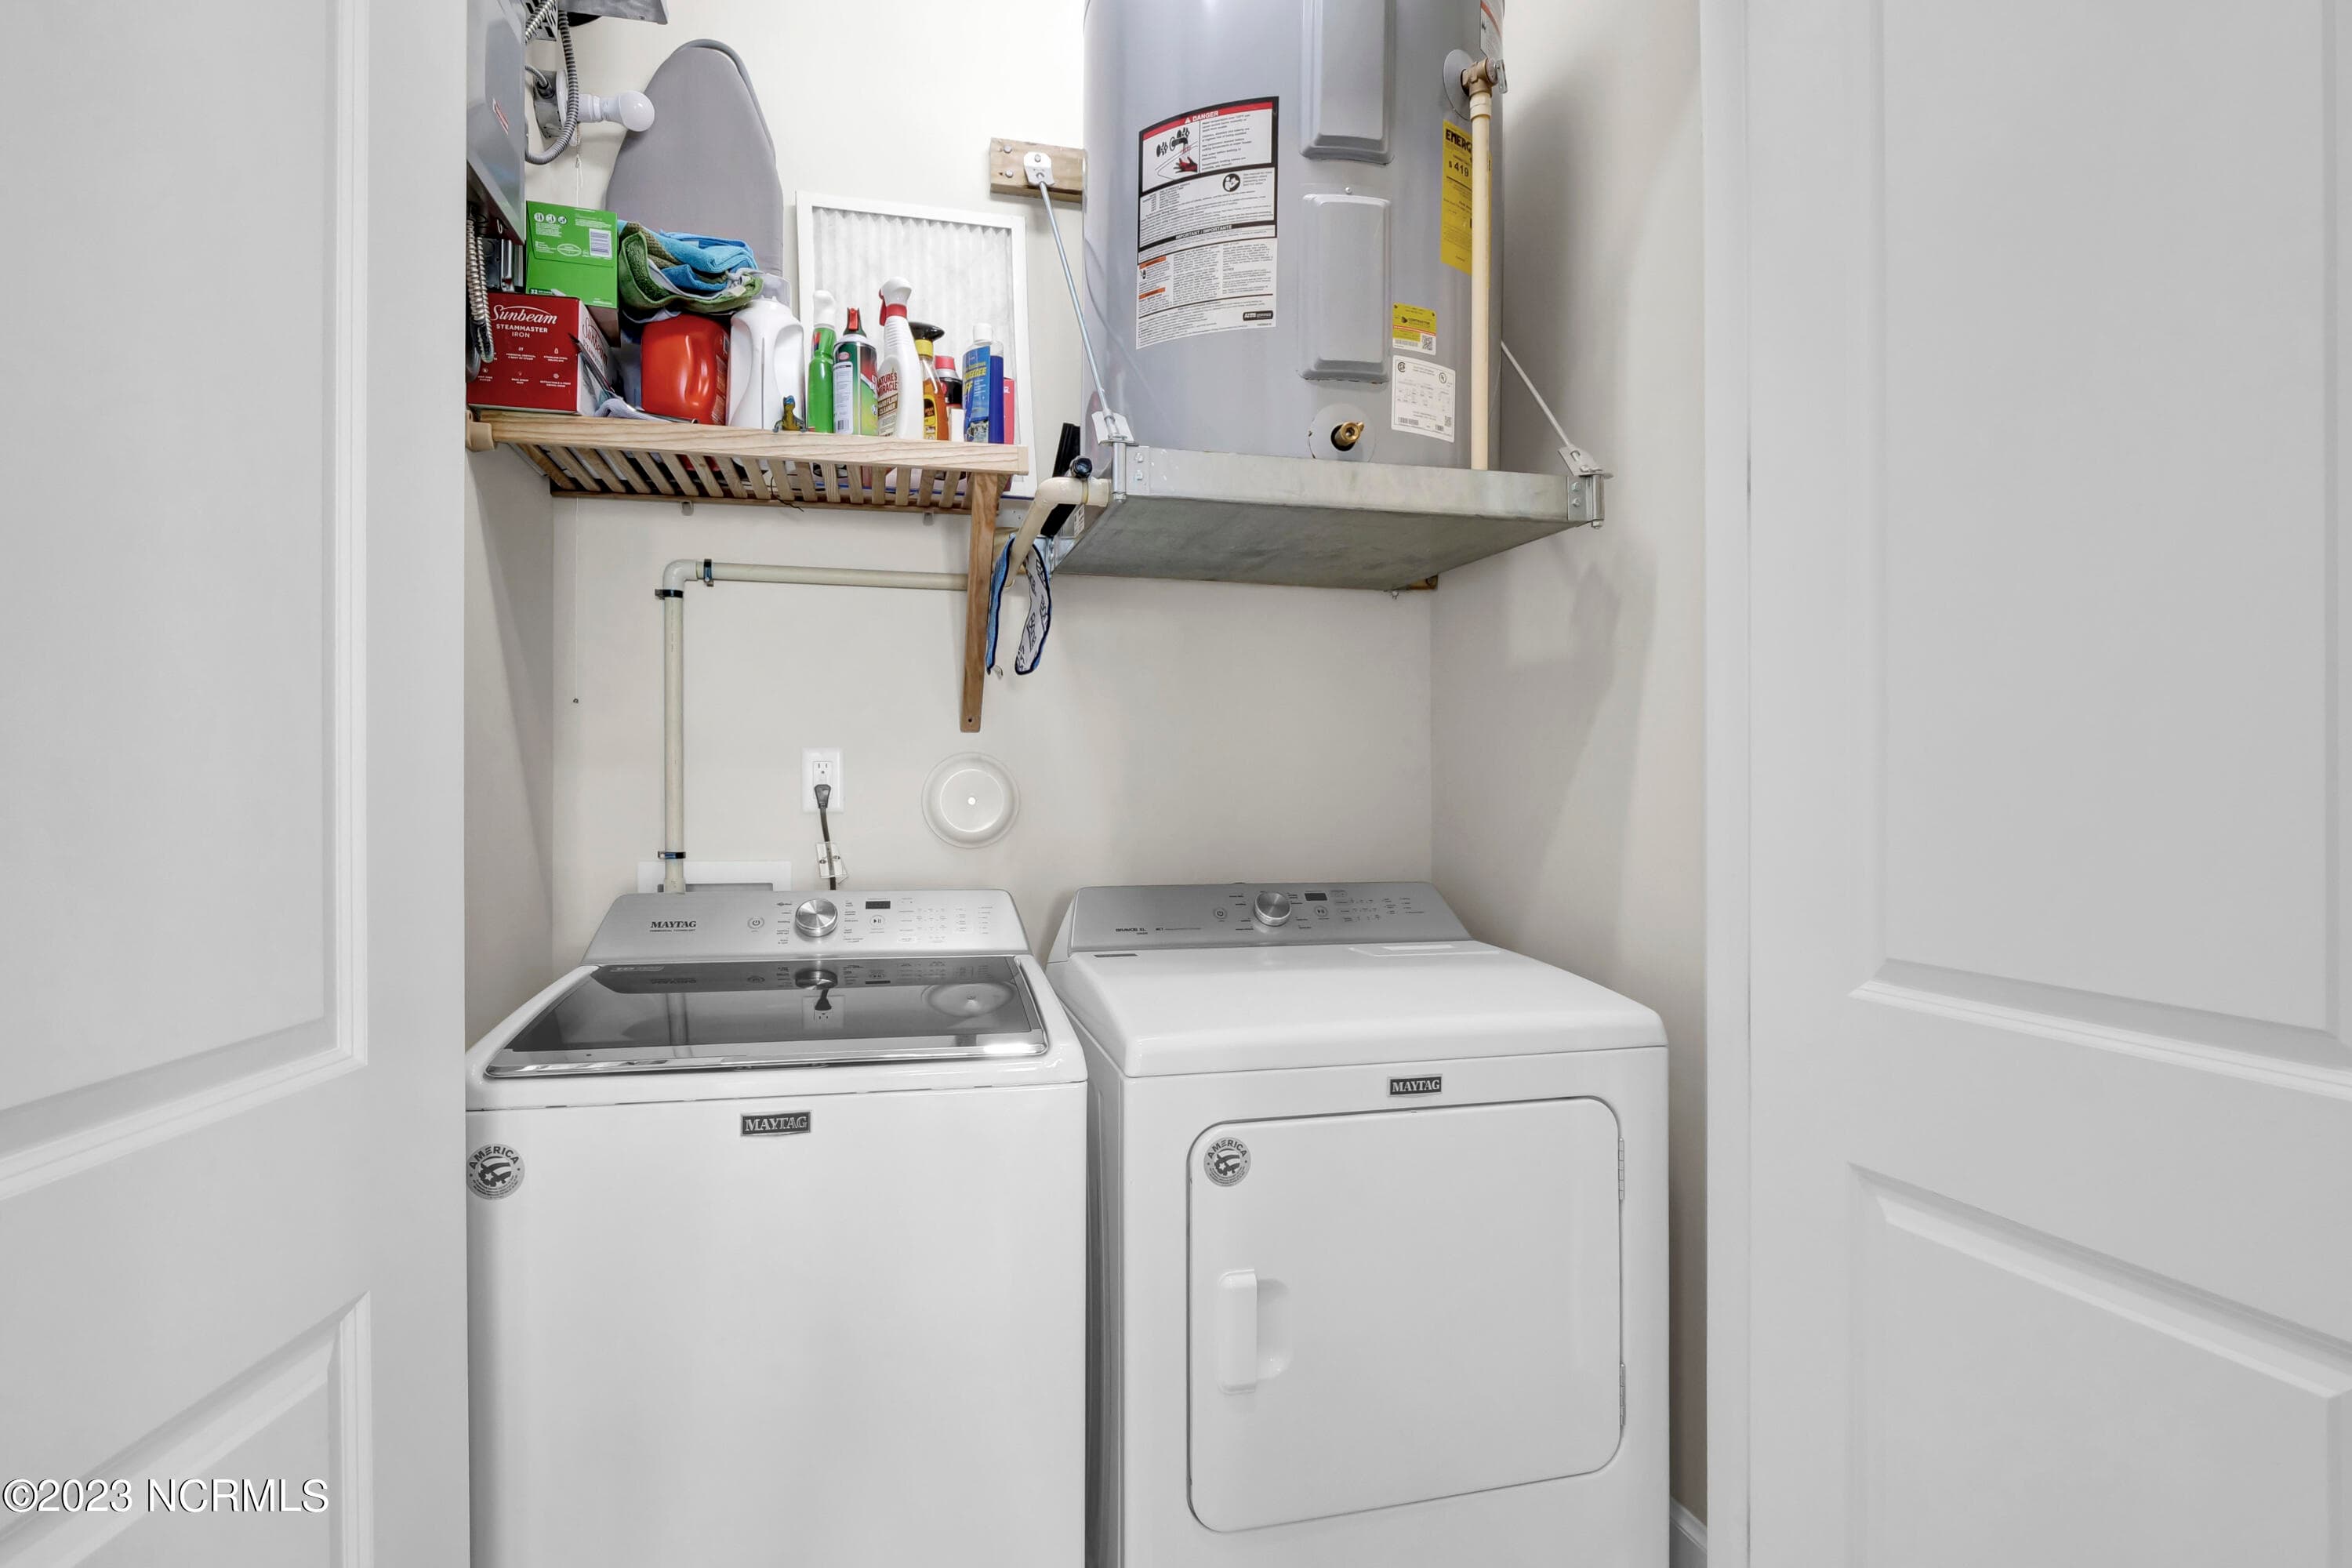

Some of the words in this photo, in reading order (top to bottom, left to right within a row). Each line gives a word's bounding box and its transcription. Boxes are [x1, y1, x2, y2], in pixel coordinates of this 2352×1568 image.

[1192, 111, 1219, 122] DANGER
[1454, 162, 1469, 178] 419
[1175, 230, 1200, 240] IMPORTANT
[491, 304, 558, 325] Sunbeam
[495, 324, 548, 333] STEAMMASTER
[582, 317, 608, 367] Sunbeam
[1392, 1080, 1440, 1092] MAYTAG
[745, 1116, 808, 1131] MAYTAG
[1207, 1139, 1247, 1160] AMERICA
[469, 1146, 519, 1170] AMERICA
